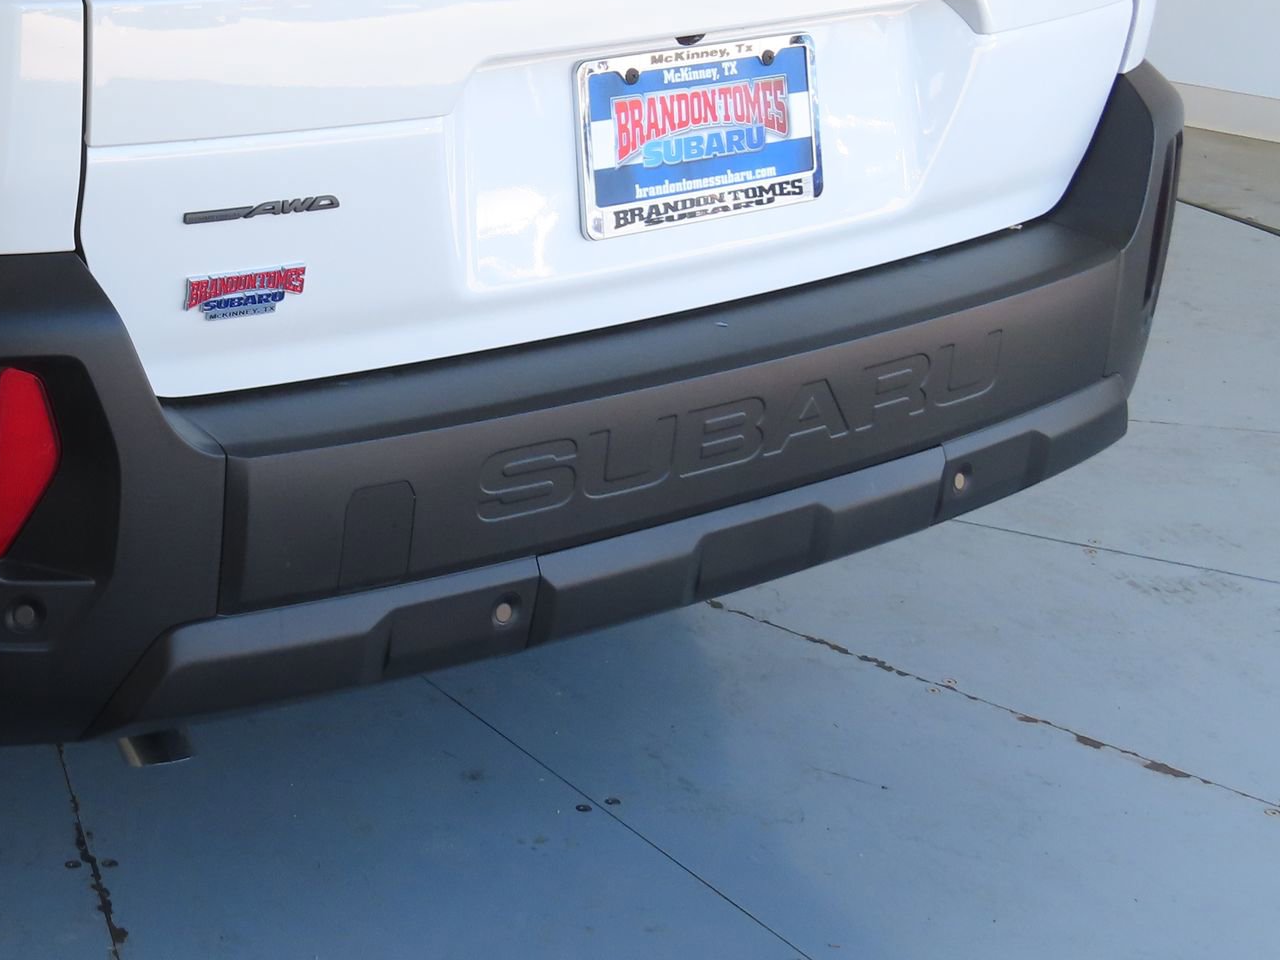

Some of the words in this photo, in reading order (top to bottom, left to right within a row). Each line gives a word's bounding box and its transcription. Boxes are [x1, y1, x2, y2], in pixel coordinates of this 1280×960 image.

[651, 48, 730, 65] McKinney,
[736, 44, 753, 53] Tx
[663, 67, 720, 84] McKinney,
[722, 61, 738, 76] TX
[614, 88, 720, 162] BRANDON
[720, 78, 788, 135] TOMES
[642, 125, 766, 168] SUBARU
[635, 166, 776, 199] brandontomessubaru.com
[243, 194, 340, 219] AWD
[613, 192, 725, 230] BRANDON
[727, 178, 804, 202] TOMES
[644, 197, 775, 226] SUBARU
[187, 274, 257, 310] BRANDON
[256, 266, 306, 293] TOMES
[202, 290, 285, 311] SUBARU
[475, 329, 1003, 522] SUBARU
